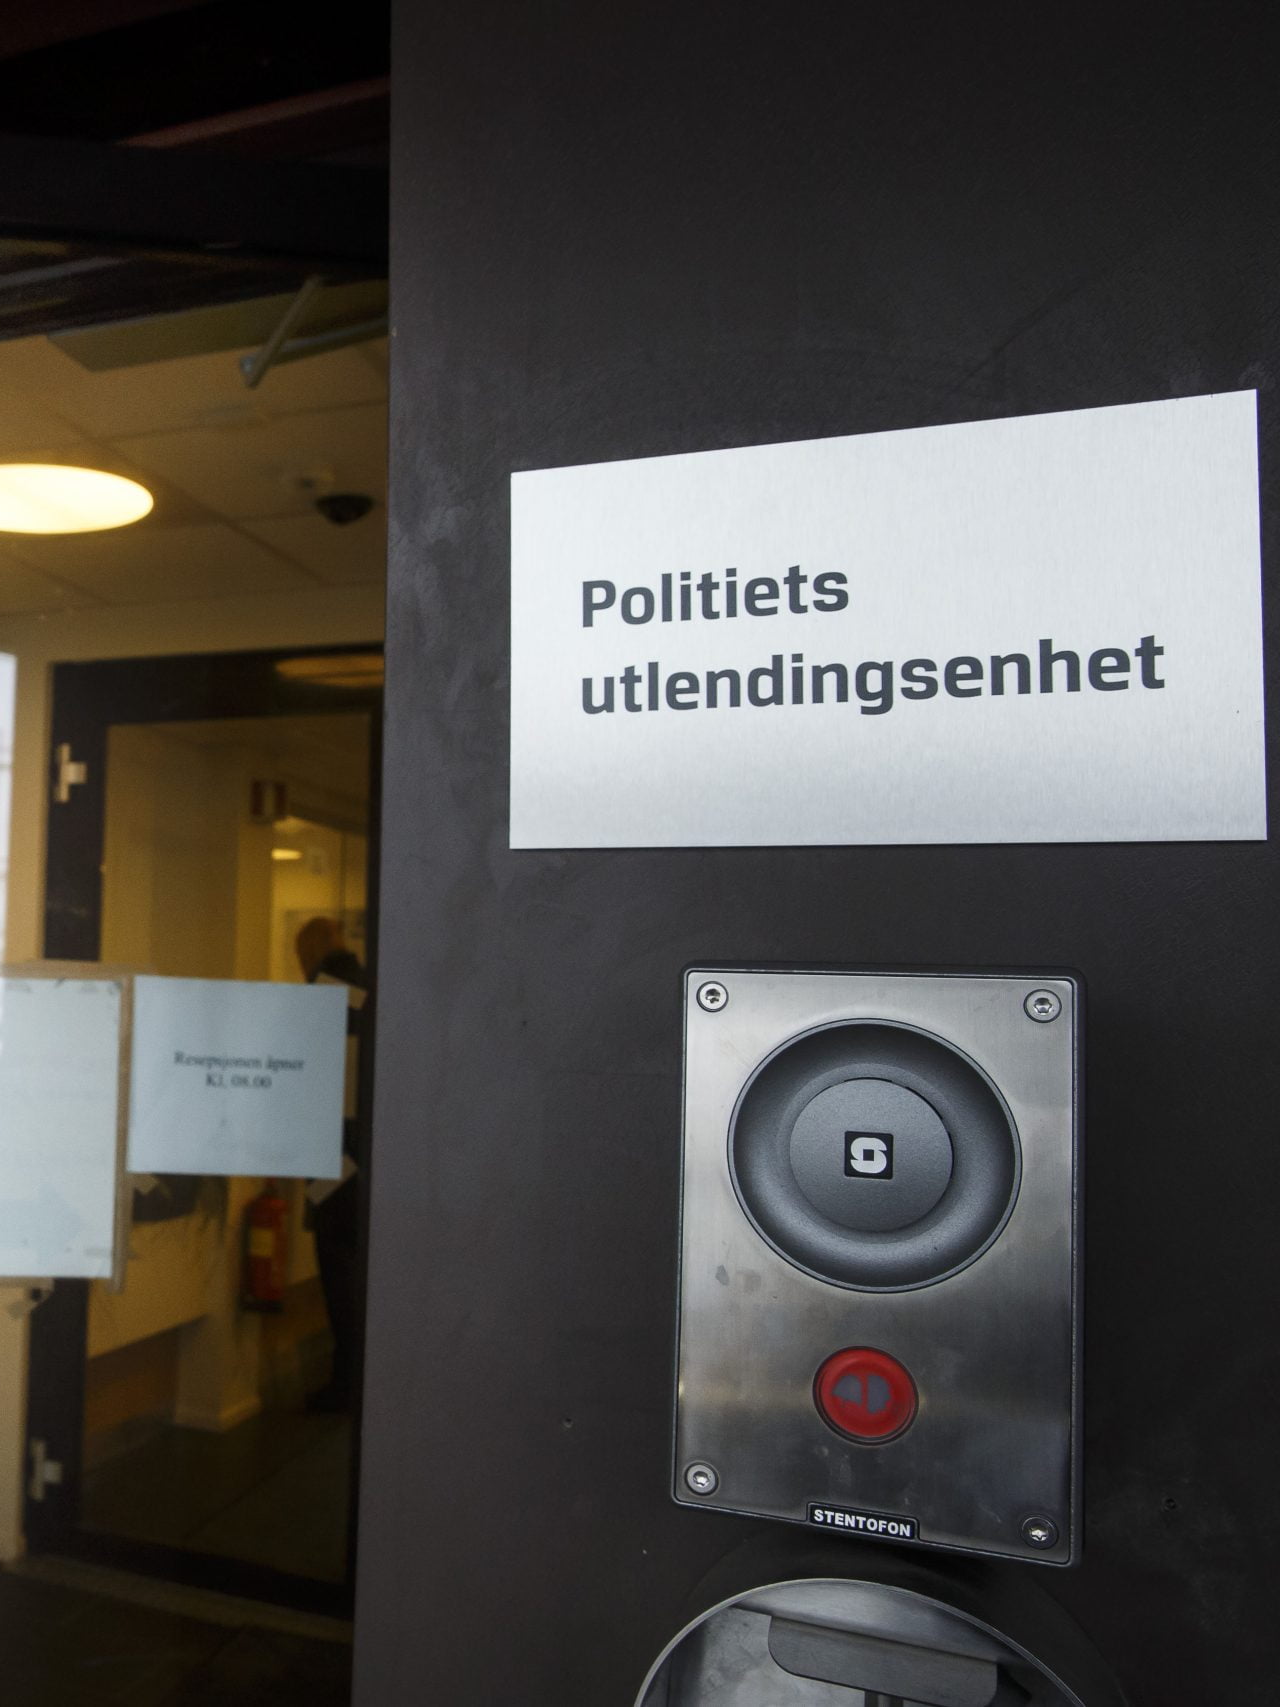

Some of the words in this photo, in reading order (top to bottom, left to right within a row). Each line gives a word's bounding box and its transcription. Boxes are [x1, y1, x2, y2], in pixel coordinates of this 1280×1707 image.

[582, 564, 850, 628] Politiets
[582, 635, 1166, 716] utlendingsenhet
[813, 1509, 911, 1537] STENTOFON
